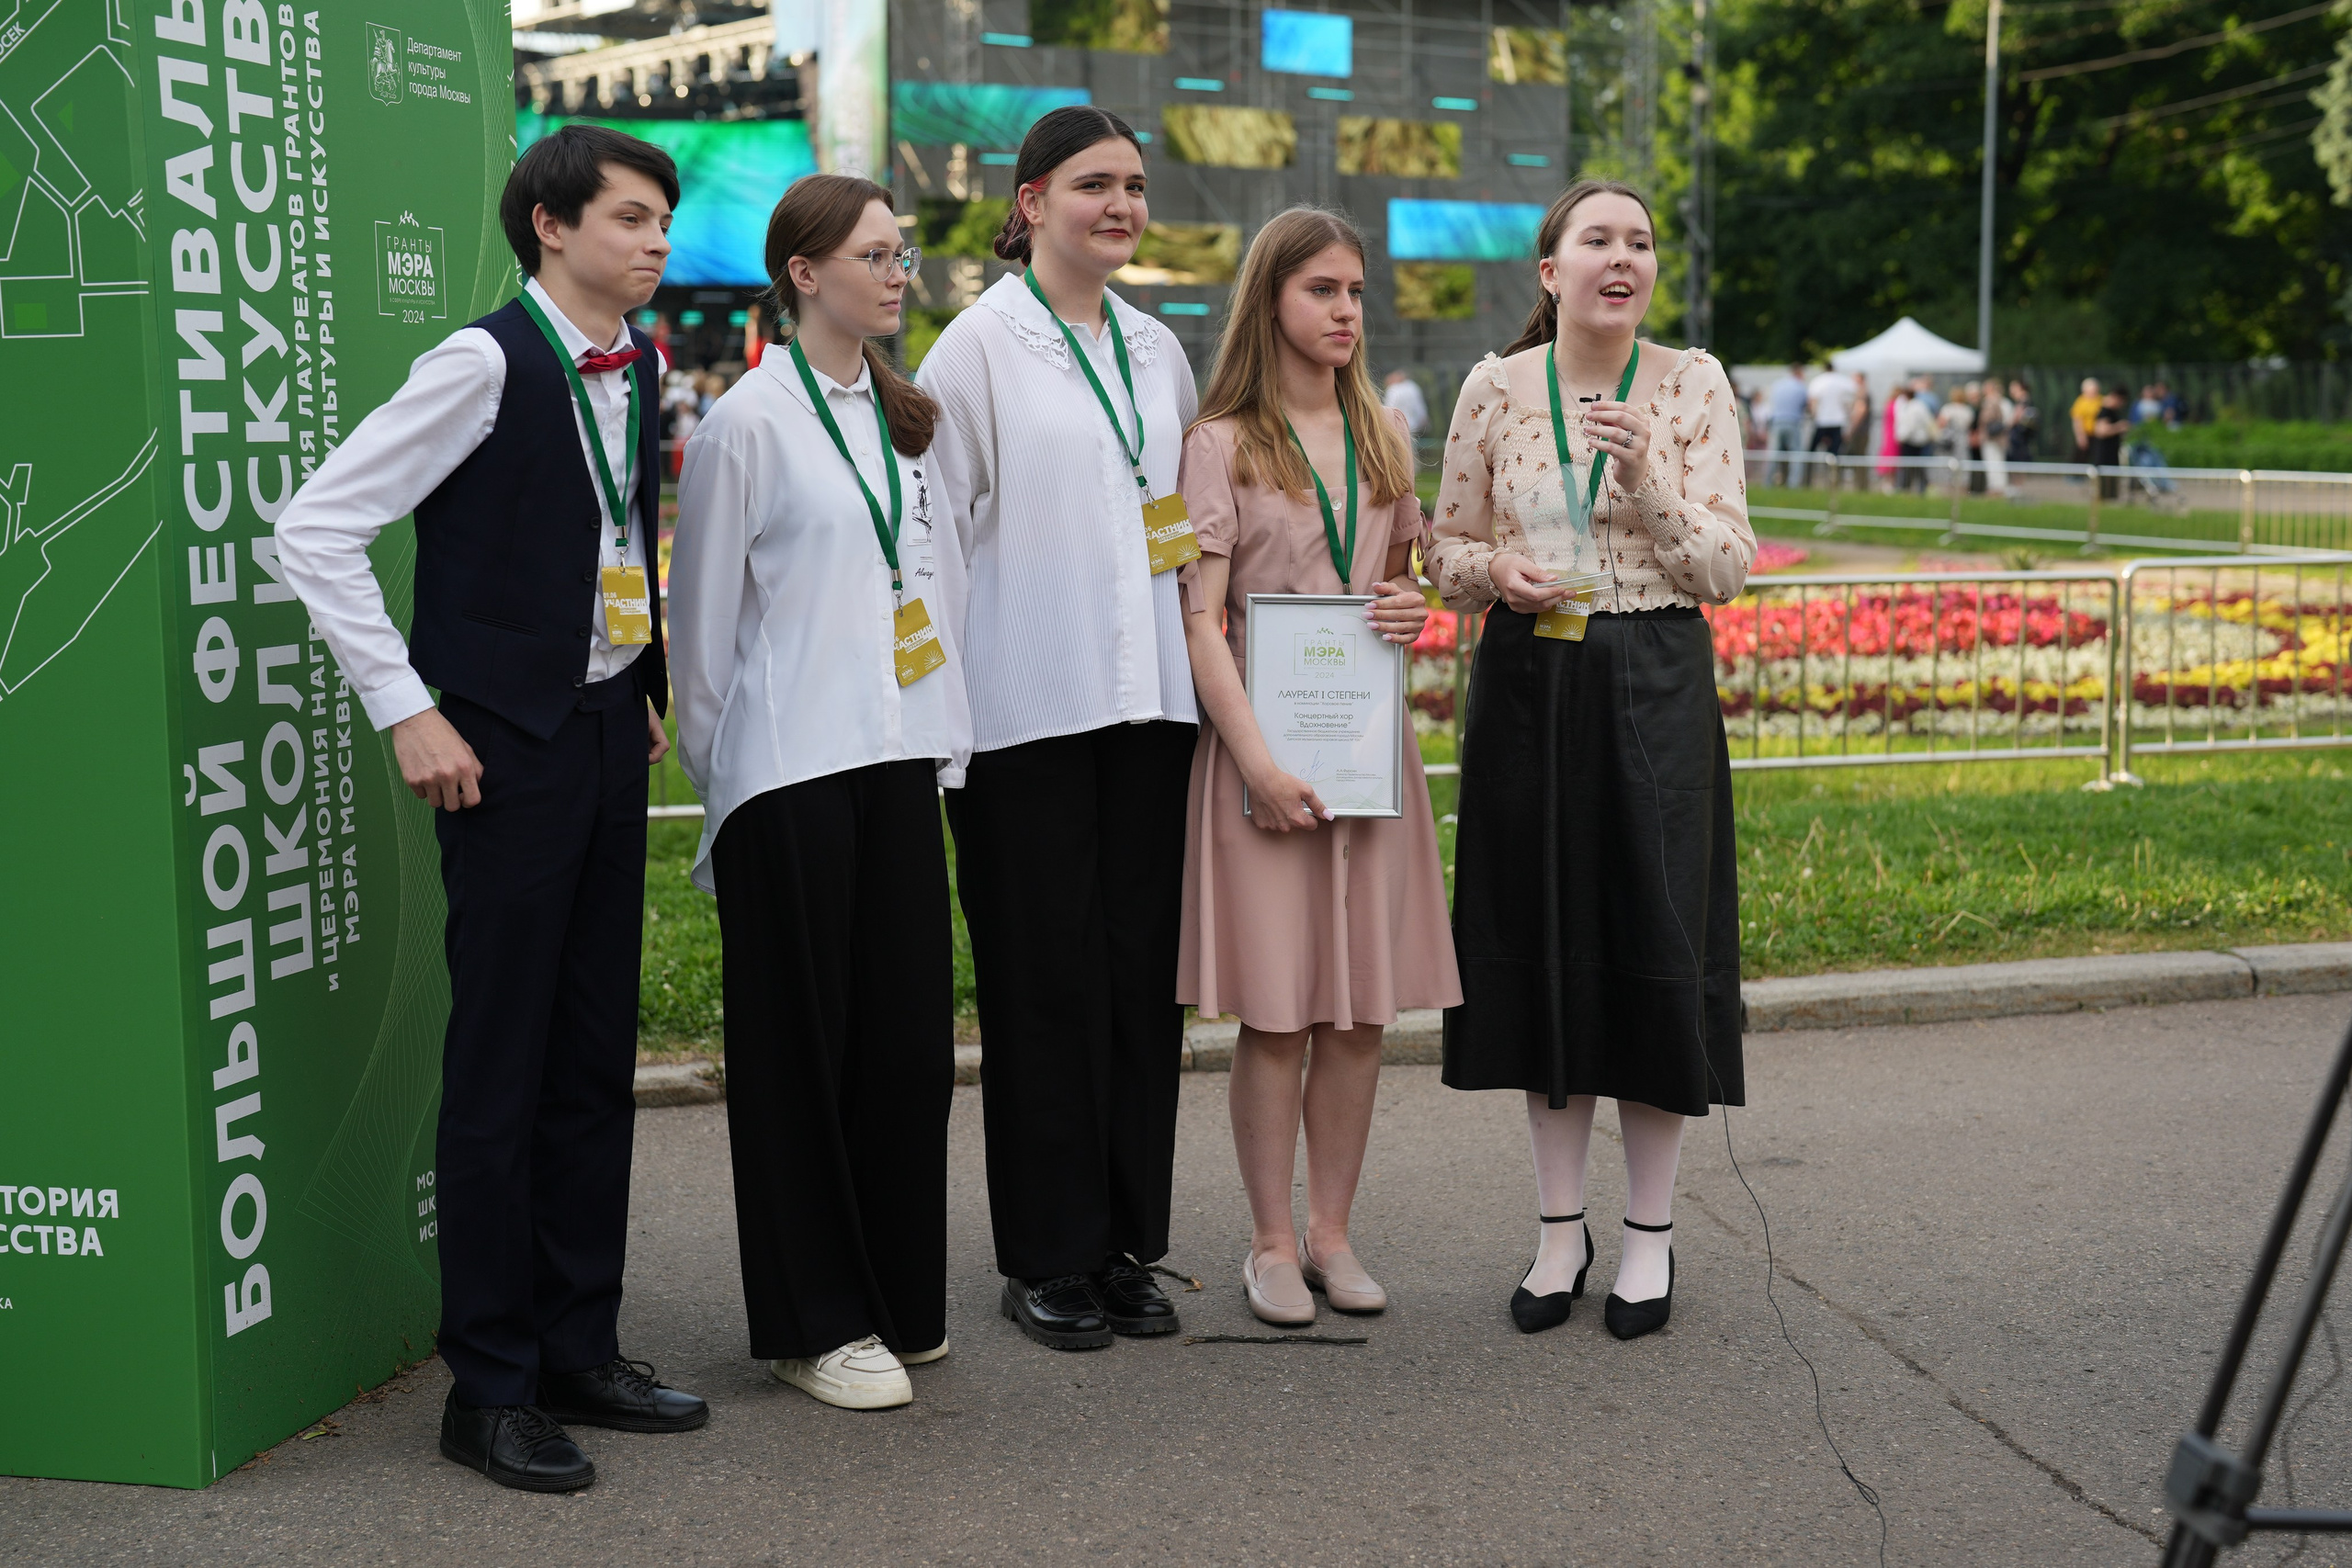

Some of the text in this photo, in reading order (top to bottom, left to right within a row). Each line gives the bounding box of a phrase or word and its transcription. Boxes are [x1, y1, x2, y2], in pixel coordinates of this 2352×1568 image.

[407, 37, 462, 62] Департамент
[408, 61, 447, 81] культуры
[277, 4, 303, 182] ГРАНТОВ
[409, 82, 471, 104] города Москвы
[303, 10, 339, 460] УЛЬТУРЫ И ИСКУССТВА
[387, 235, 433, 254] ГРАНТЫ
[387, 251, 434, 278] МЭРА
[389, 277, 435, 297] МОСКВЫ
[288, 194, 314, 419] ЛАУРЕАТОВ
[402, 310, 424, 323] 2024
[222, 0, 314, 981] ШКОЛ ИСКУССТВ
[1146, 518, 1191, 540] ЧАСТНИК
[604, 598, 647, 608] УЧАСТНИК
[894, 624, 934, 651] ЧАСТНИК
[1305, 638, 1345, 647] ГРАНТЫ
[1304, 646, 1345, 658] МЭРА
[1304, 658, 1346, 666] МОСКВЫ
[154, 0, 272, 1337] БОЛЬШОЙ ФЕСТИВАЛЬ
[1278, 690, 1319, 699] ЛАУРЕАТ
[1327, 691, 1371, 700] СТЕПЕНИ
[1294, 712, 1339, 720] Концертный
[334, 669, 361, 944] МЭРА МОСКВЫ
[312, 728, 340, 964] ЦЕРЕМОНИЯ
[328, 972, 339, 992] и
[416, 1170, 436, 1192] МО
